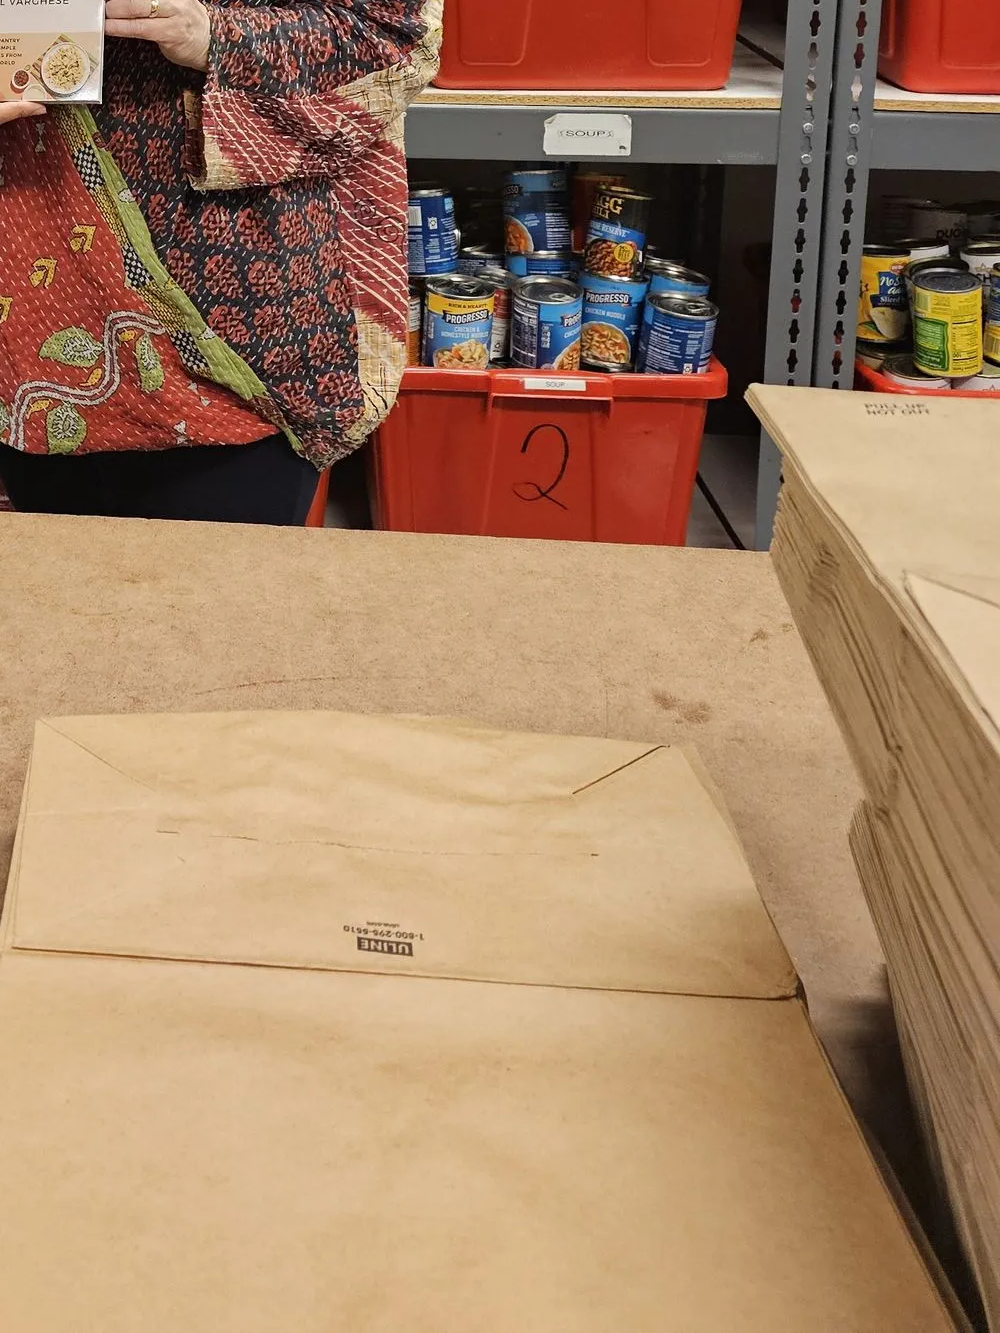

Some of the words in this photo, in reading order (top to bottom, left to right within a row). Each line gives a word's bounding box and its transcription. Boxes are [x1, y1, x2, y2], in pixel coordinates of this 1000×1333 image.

[585, 292, 630, 304] PROGRESSO
[446, 310, 488, 324] PROGRESSO
[545, 380, 566, 389] SOUP
[512, 423, 569, 511] 2
[359, 938, 410, 955] ULINE
